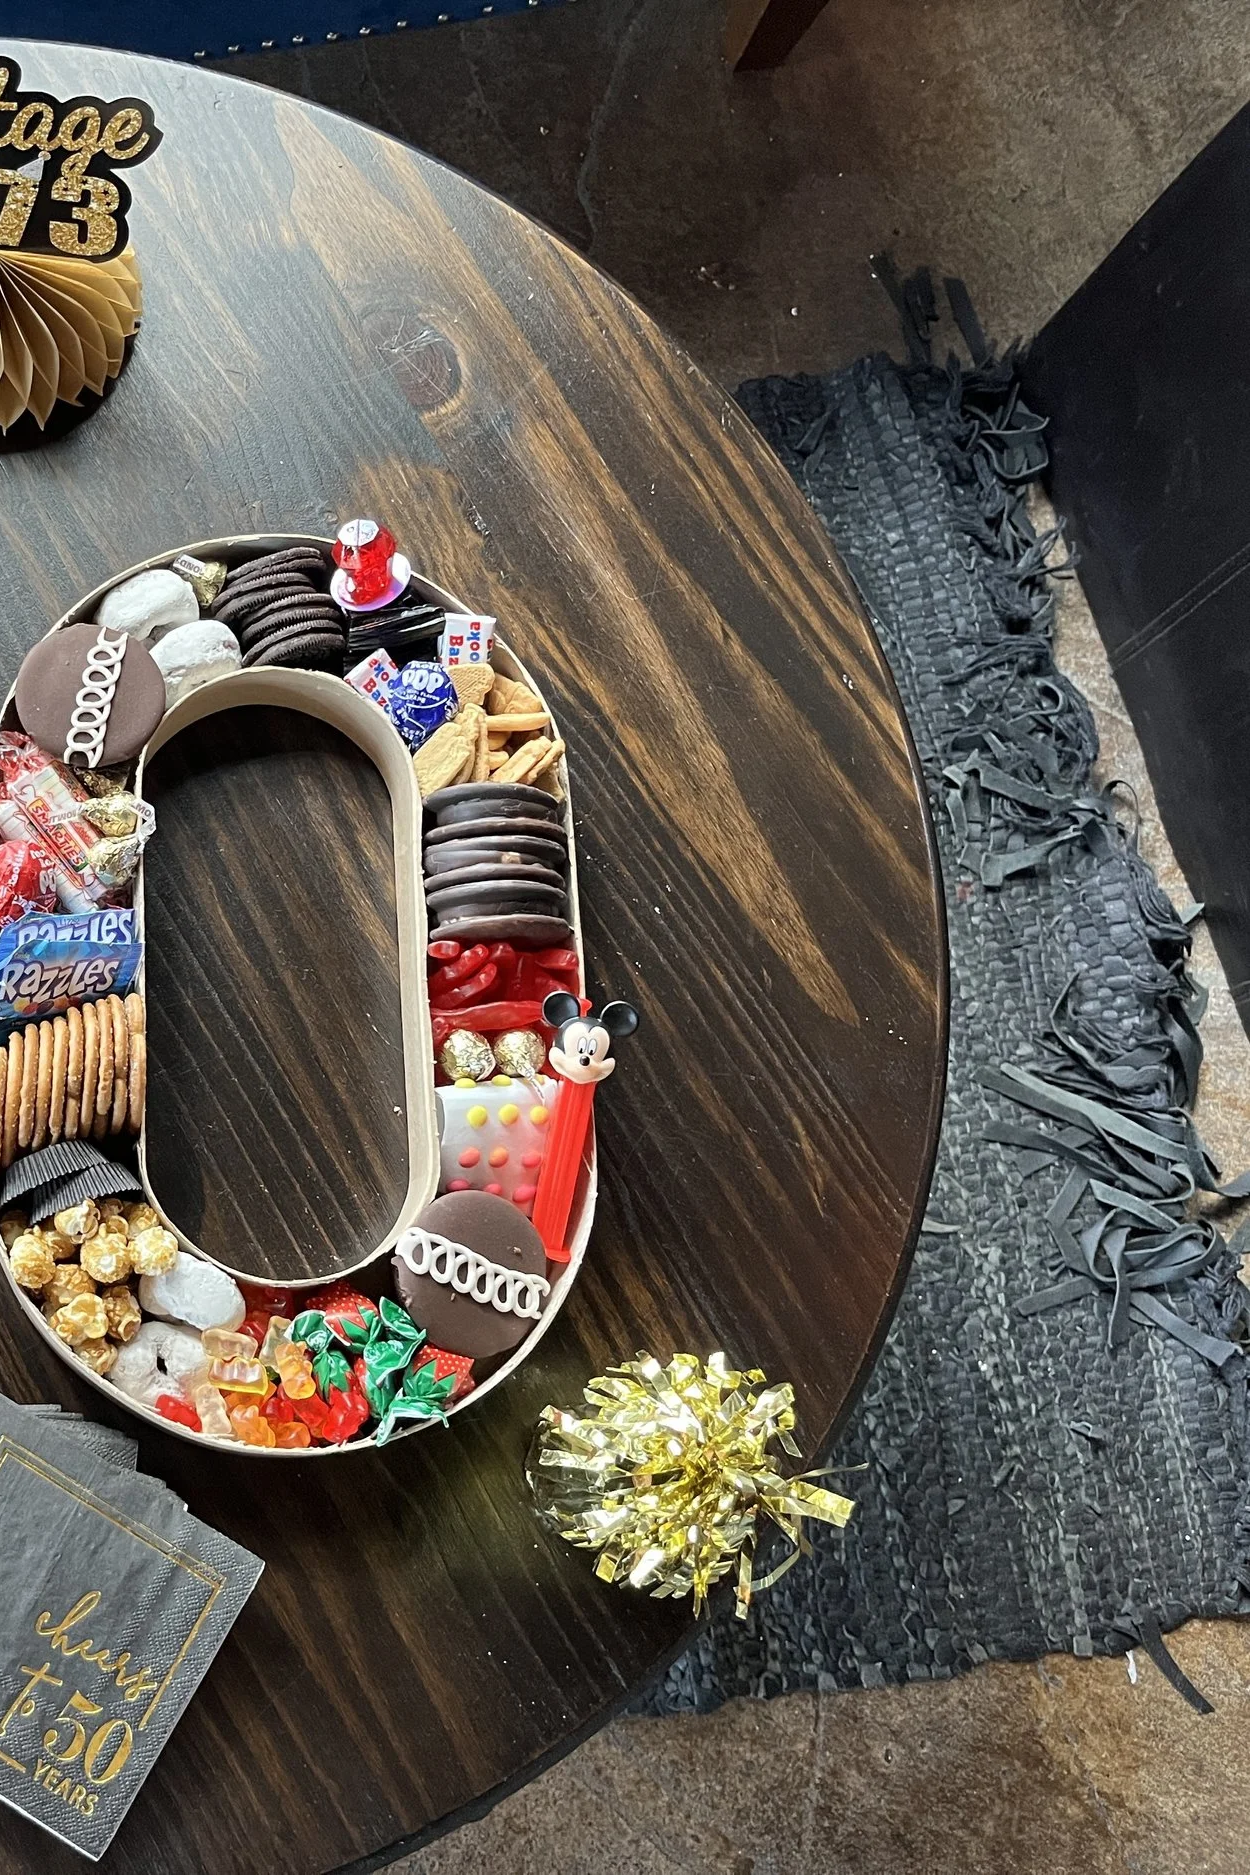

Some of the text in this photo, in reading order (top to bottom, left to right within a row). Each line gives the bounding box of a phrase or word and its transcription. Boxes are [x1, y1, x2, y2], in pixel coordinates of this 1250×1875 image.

[31, 804, 85, 866] SMARTIES
[35, 1590, 157, 1701] cheers
[44, 1690, 133, 1784] 50
[32, 1758, 99, 1816] YEARS
